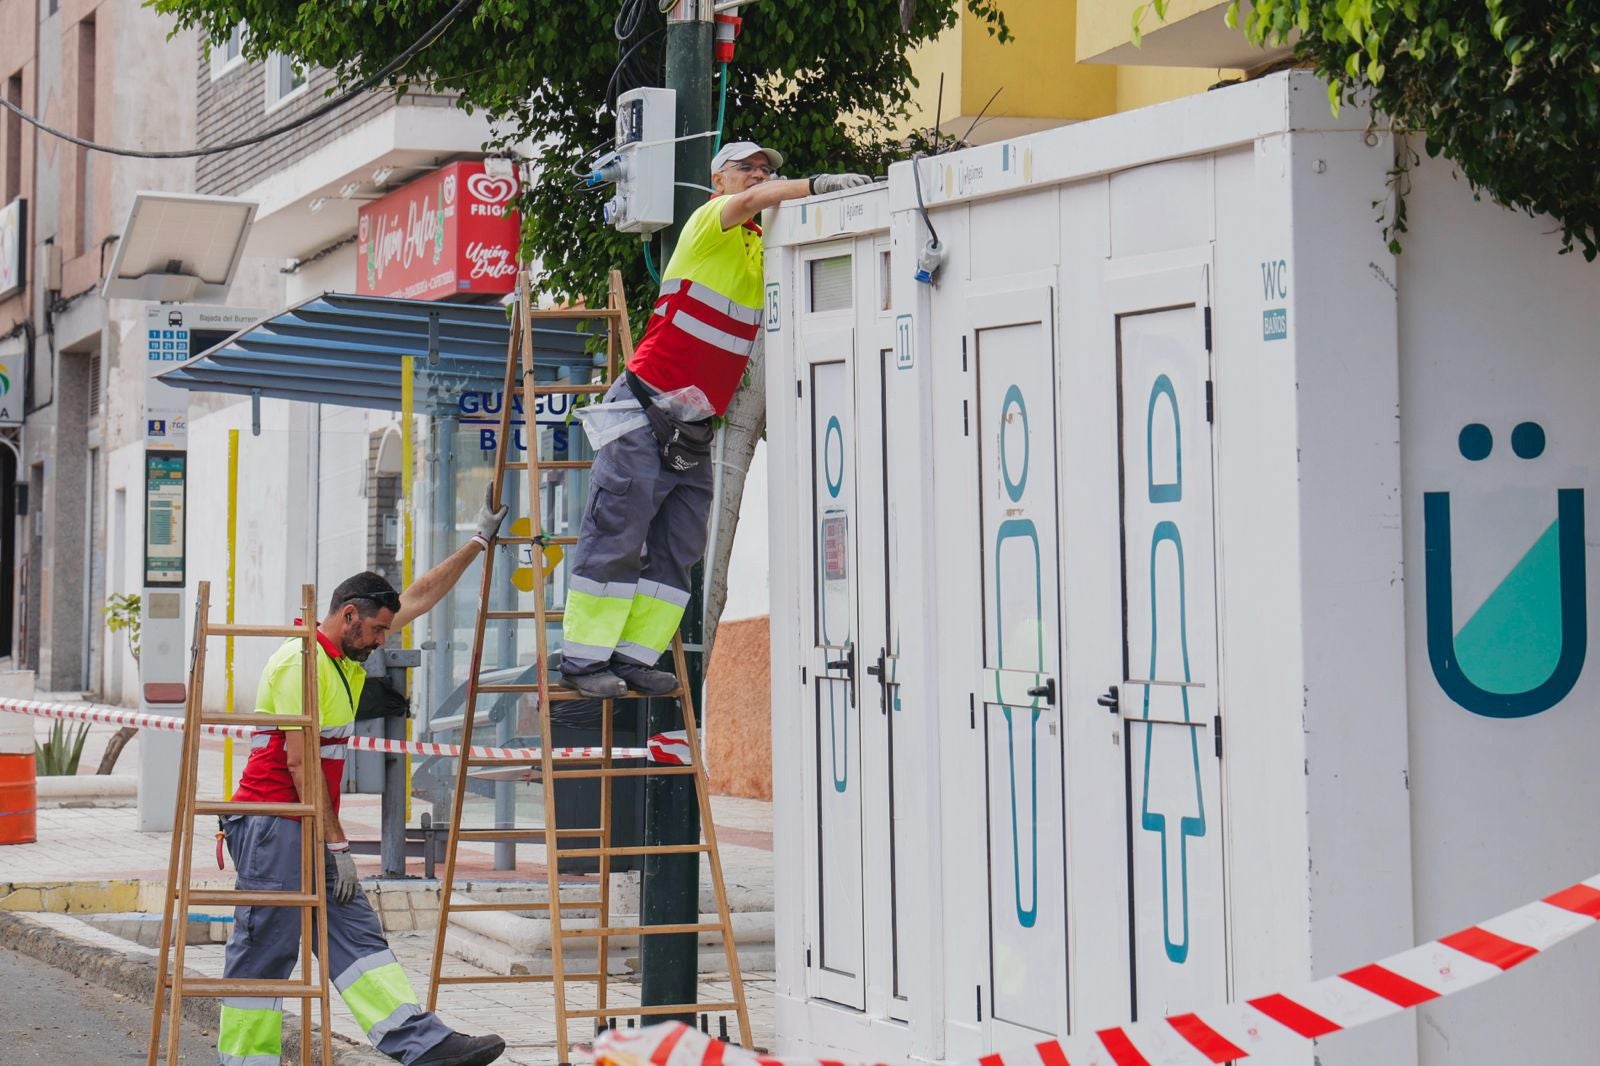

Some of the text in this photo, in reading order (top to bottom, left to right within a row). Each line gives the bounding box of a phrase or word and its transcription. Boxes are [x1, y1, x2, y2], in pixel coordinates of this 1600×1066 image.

[466, 241, 510, 263] Unión
[470, 259, 517, 279] Dulce
[1261, 259, 1287, 301] WC
[223, 314, 232, 322] del
[767, 290, 779, 324] 15
[899, 323, 911, 361] 11
